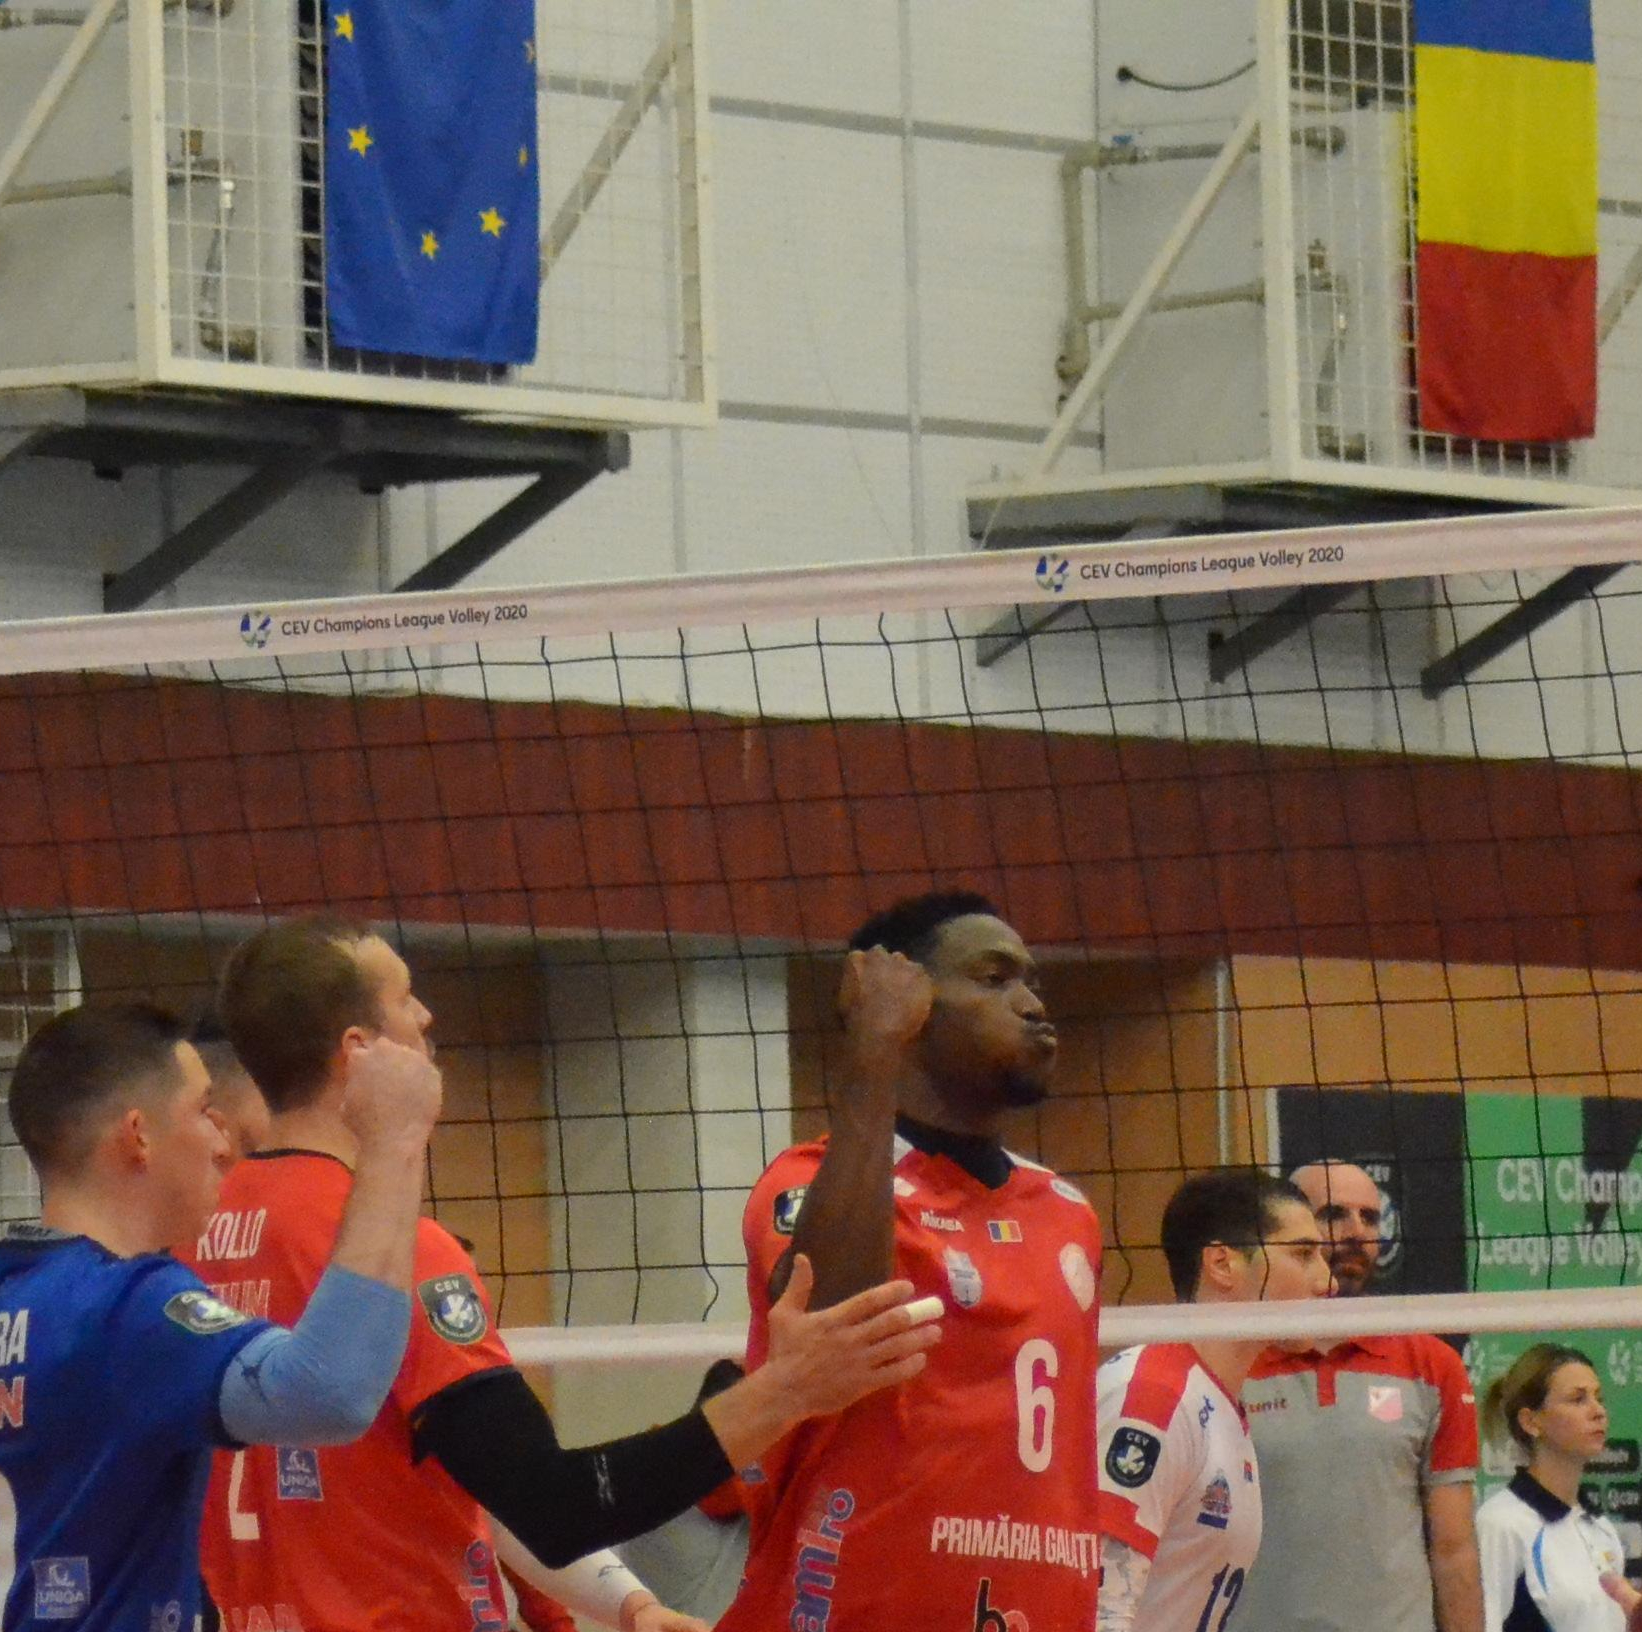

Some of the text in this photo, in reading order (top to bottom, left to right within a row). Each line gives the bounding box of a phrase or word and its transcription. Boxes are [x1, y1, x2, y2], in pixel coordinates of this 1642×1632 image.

[1081, 546, 1344, 580] CEV Champions League Volley 2020
[281, 604, 528, 636] CEV Champions League Volley 2020
[1497, 1158, 1544, 1202] CEV
[1479, 1222, 1571, 1277] League
[1015, 1337, 1058, 1473] 6
[1125, 1431, 1150, 1447] CEV
